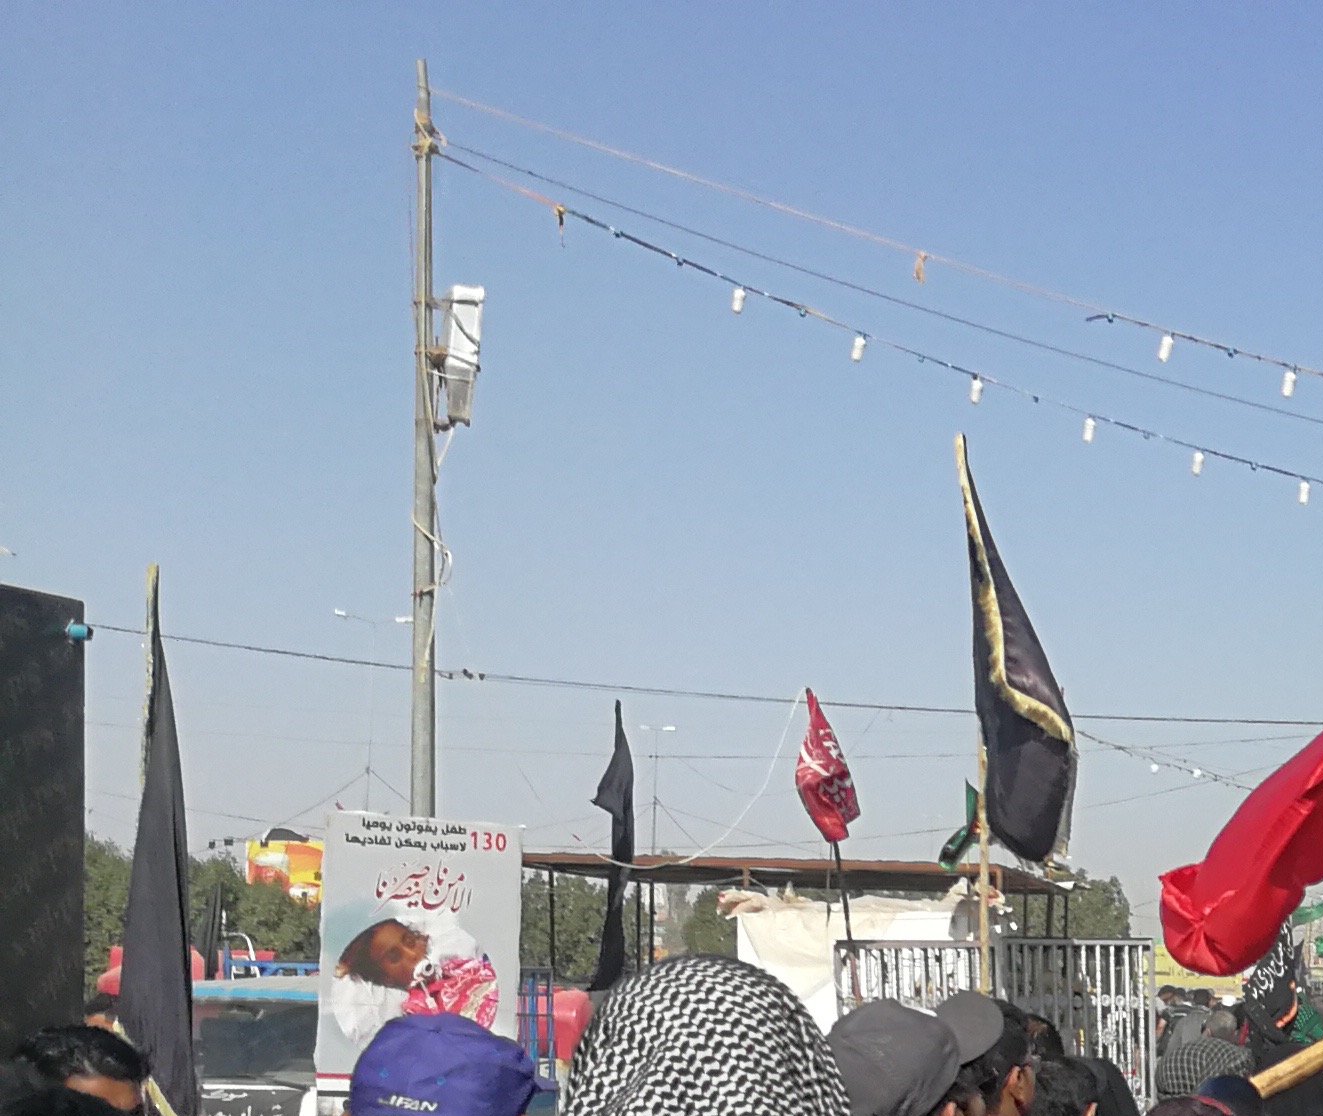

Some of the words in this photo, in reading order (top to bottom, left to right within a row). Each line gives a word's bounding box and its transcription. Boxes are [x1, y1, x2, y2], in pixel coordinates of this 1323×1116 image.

[441, 823, 467, 836] طفل
[344, 832, 391, 847] تفاديها
[394, 837, 427, 851] يمكن
[470, 831, 508, 852] 130
